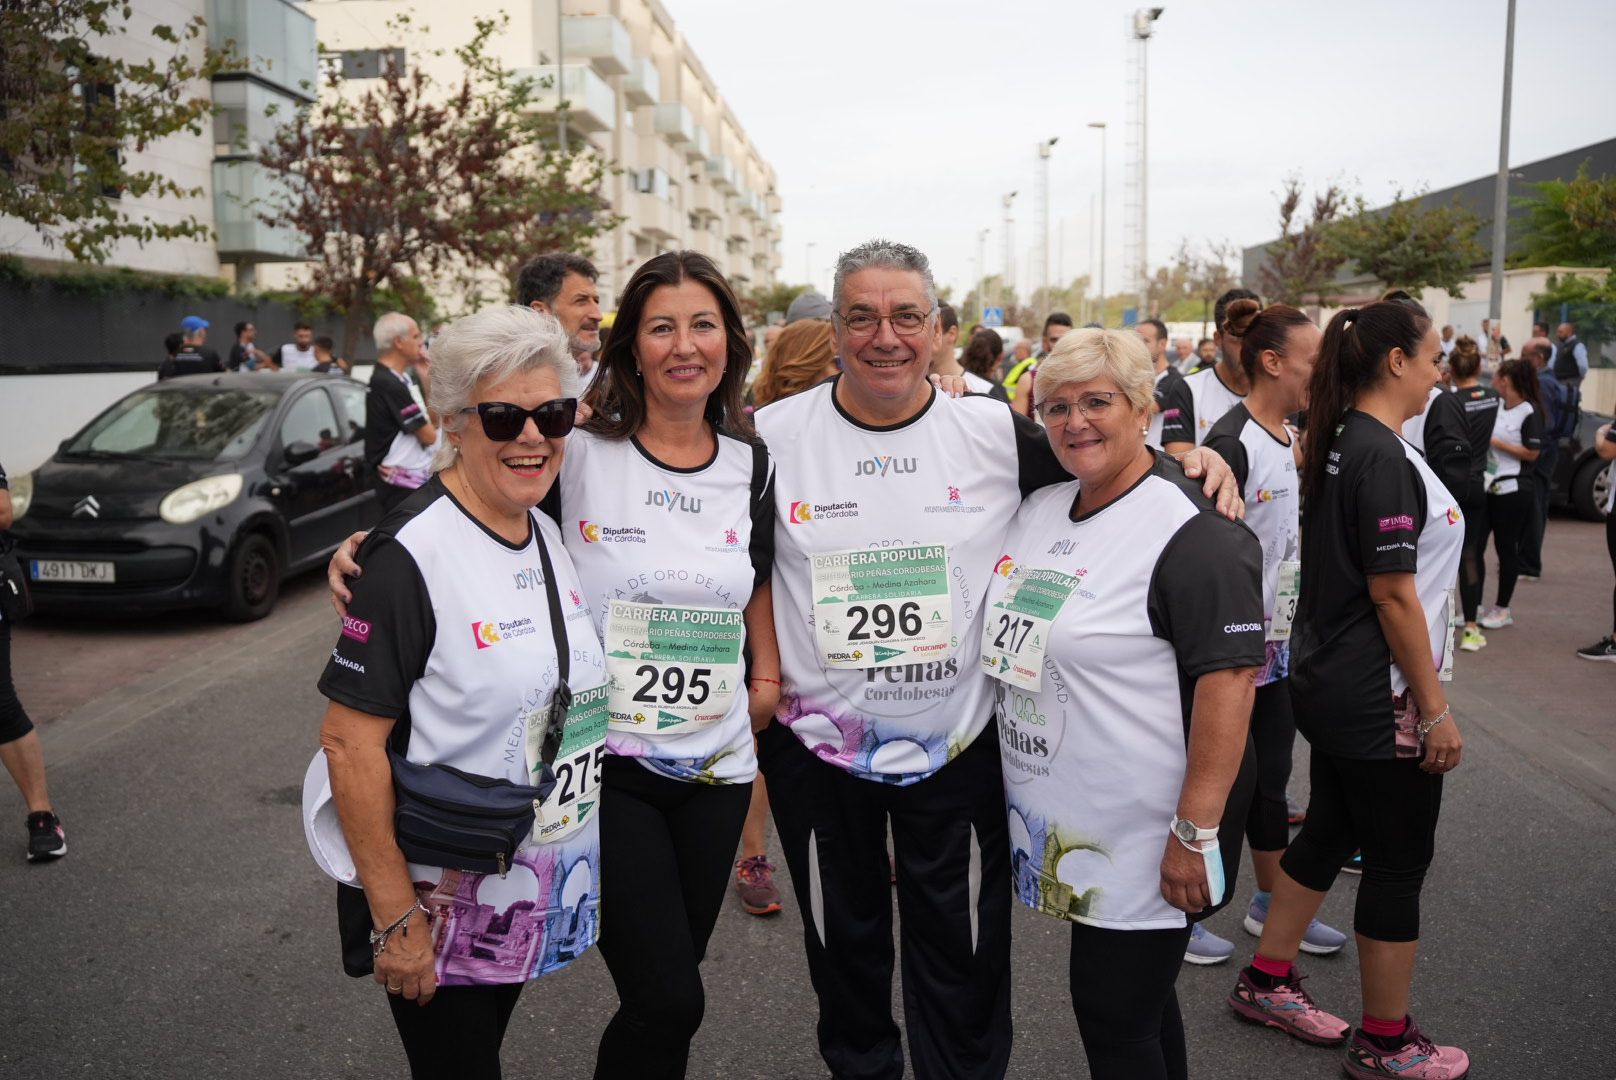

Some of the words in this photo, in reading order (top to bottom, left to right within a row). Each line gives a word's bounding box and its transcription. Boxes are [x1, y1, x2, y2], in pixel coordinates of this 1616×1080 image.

[854, 456, 917, 478] JOYLU
[645, 489, 701, 514] JOYLU
[814, 501, 858, 513] Diputación
[814, 512, 824, 520] de
[825, 509, 859, 519] Córdoba
[602, 526, 646, 536] Diputación
[614, 534, 646, 543] Córdoba
[814, 551, 878, 568] CARRERA
[881, 547, 944, 564] POPULAR
[42, 562, 75, 578] 4911
[866, 567, 892, 578] PEÑAS
[893, 564, 946, 575] CORDOBESAS
[628, 574, 649, 590] DE
[654, 570, 688, 581] ORO
[695, 574, 714, 589] DE
[715, 586, 731, 600] LA
[829, 582, 865, 592] Córdoba
[872, 580, 902, 590] Medina
[904, 578, 937, 588] Azahara
[1041, 571, 1078, 589] POPULAR
[850, 592, 881, 601] CARRERA
[884, 590, 922, 599] SOLIDARIA
[953, 566, 973, 620] CIUDAD
[613, 605, 678, 622] CARRERA
[681, 610, 743, 627] POPULAR
[846, 602, 923, 641] 296
[343, 616, 369, 634] DECO
[499, 617, 532, 631] Diputación
[1224, 622, 1262, 633] CÓRDOBA
[503, 631, 513, 640] de
[664, 627, 691, 639] PEÑAS
[692, 630, 741, 641] CORDOBESAS
[993, 614, 1034, 654] 217
[623, 638, 661, 650] Córdoba
[668, 642, 698, 652] Medina
[701, 644, 730, 653] Azahara
[913, 643, 948, 653] Cruzcampo
[643, 653, 676, 662] CARRERA
[679, 655, 716, 664] SOLIDARIA
[632, 664, 711, 705] 295
[694, 713, 724, 722] Cruzcampo
[570, 726, 593, 739] Medina
[593, 717, 608, 729] Azah
[556, 744, 605, 806] 275
[541, 821, 561, 836] PIEDRA
